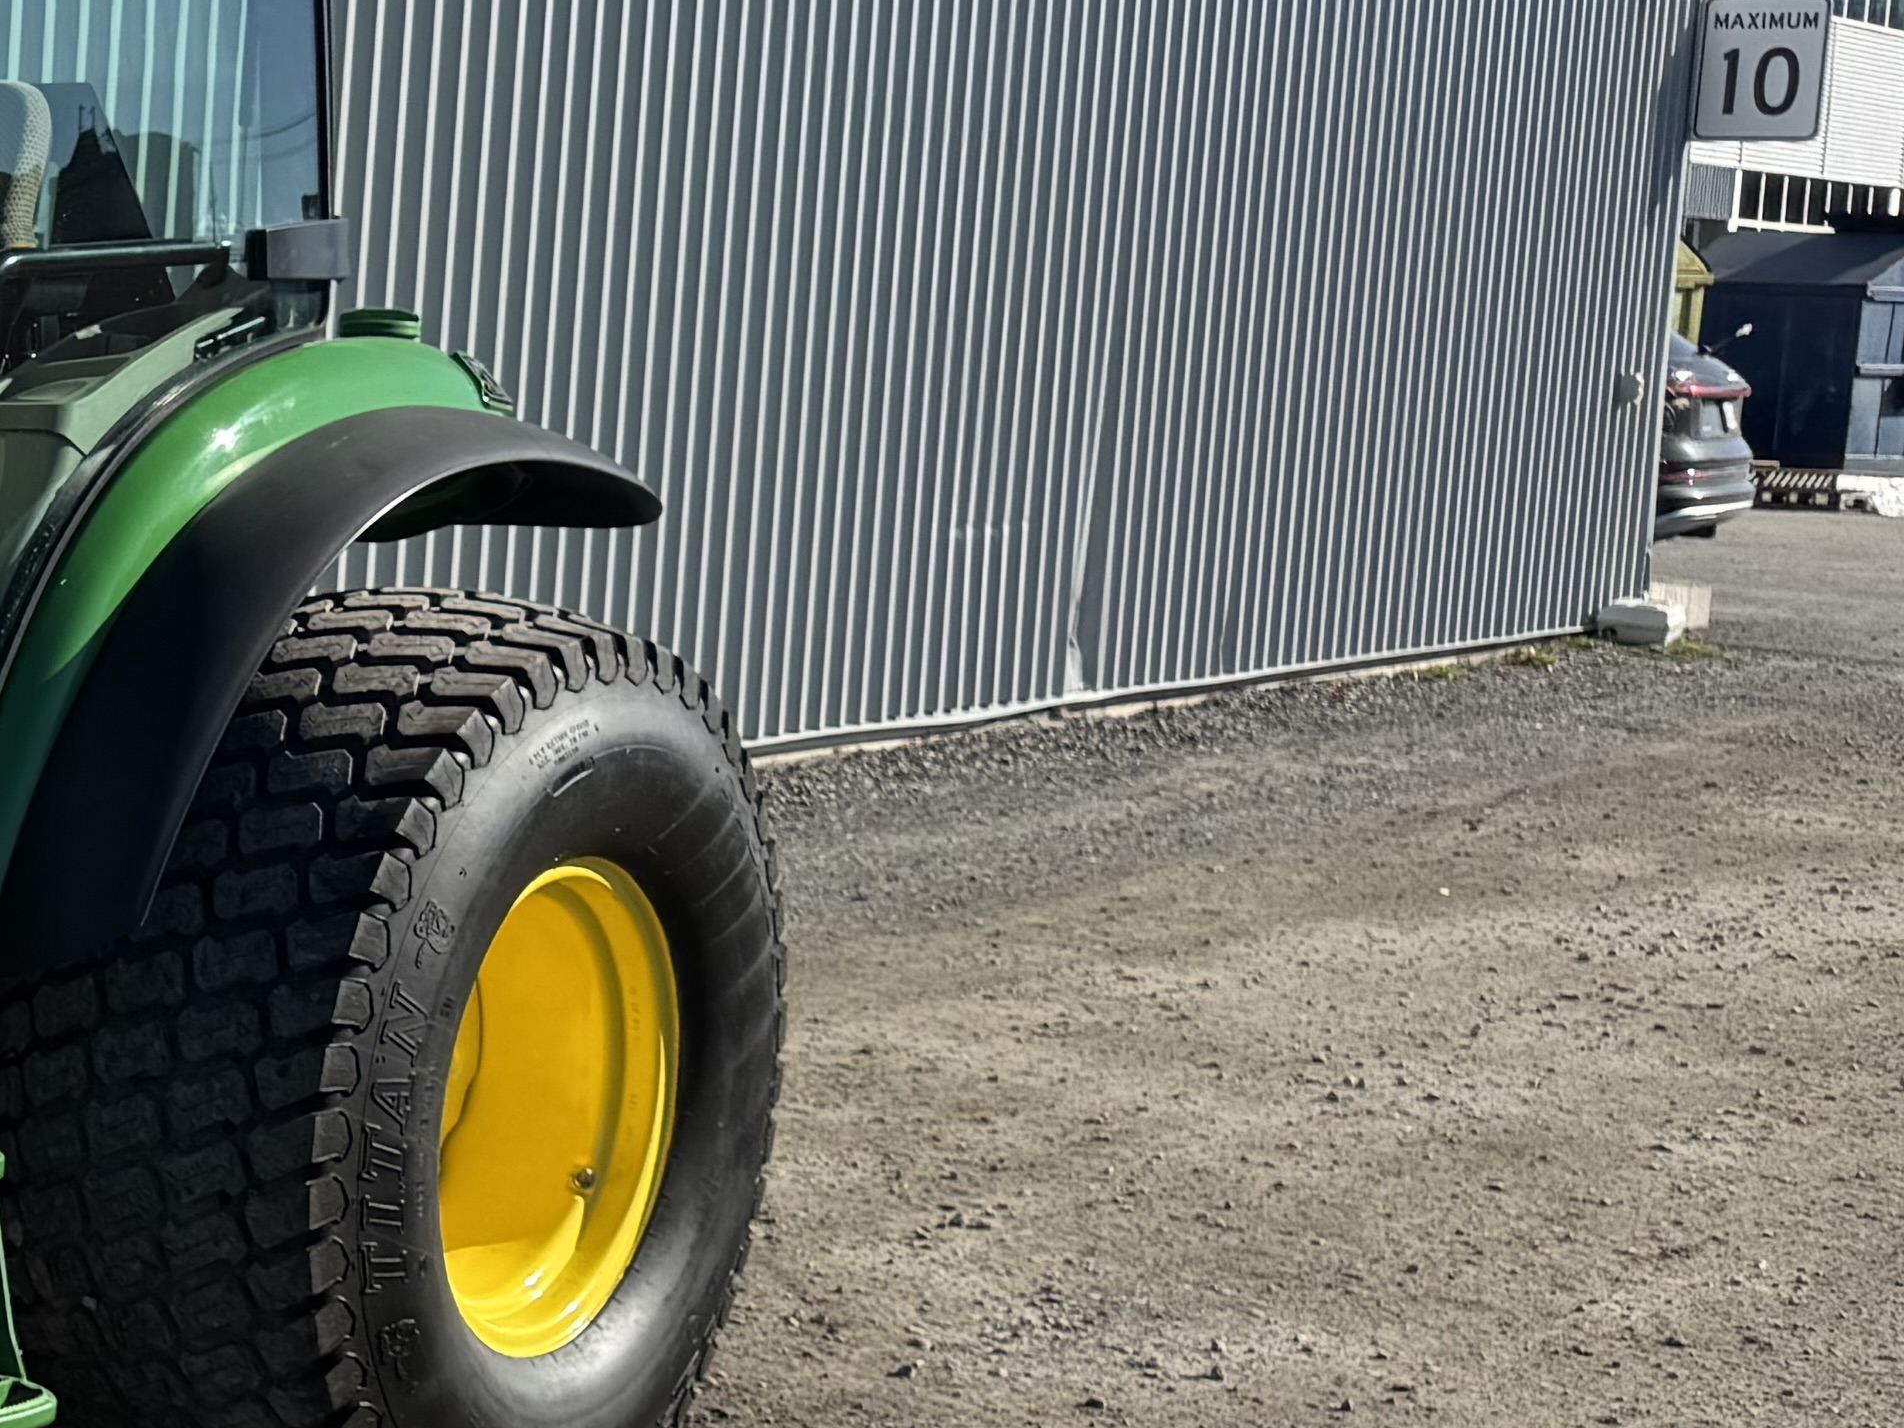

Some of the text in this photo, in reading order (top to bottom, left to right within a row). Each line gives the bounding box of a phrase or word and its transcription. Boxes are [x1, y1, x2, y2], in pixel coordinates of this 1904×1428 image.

[1714, 11, 1819, 30] MAXIMUM
[1722, 47, 1800, 116] 10
[360, 977, 429, 1295] TITAN
